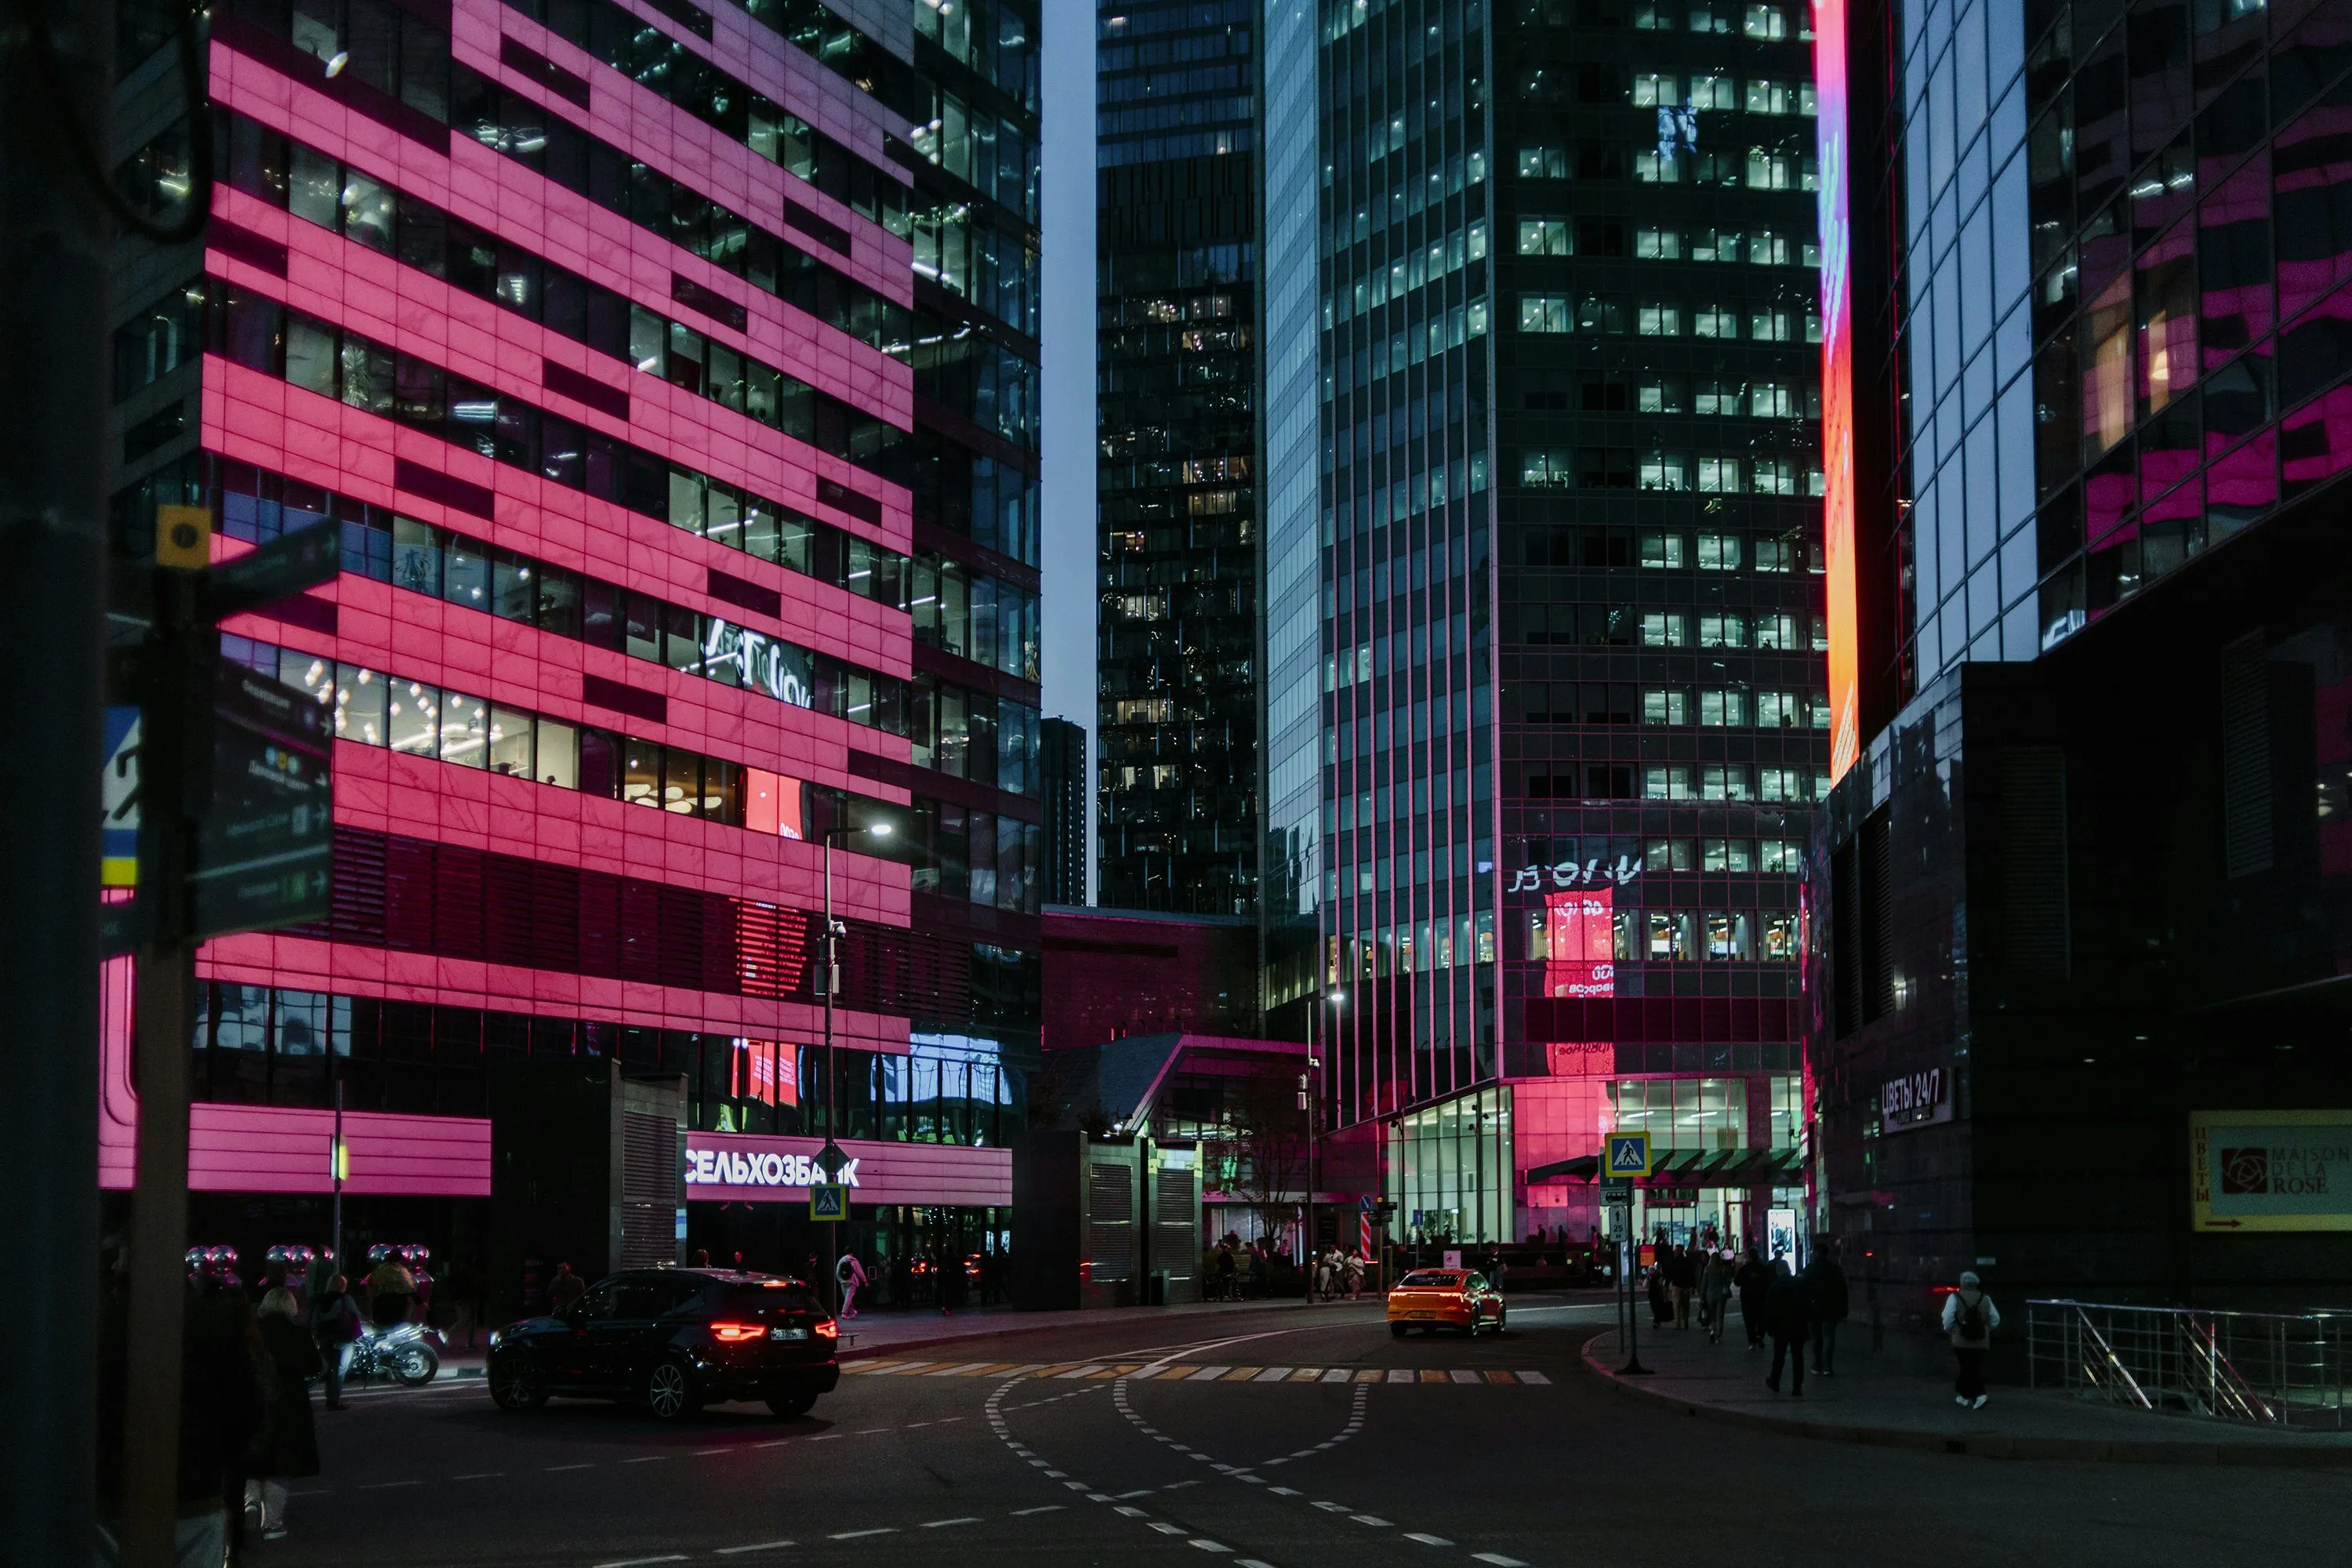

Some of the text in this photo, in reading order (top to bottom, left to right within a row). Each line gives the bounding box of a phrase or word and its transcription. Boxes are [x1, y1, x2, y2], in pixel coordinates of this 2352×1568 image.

[1882, 1067, 1940, 1119] ЦВЕТЫ 24/7
[2272, 1147, 2350, 1162] MAISON
[2272, 1178, 2328, 1195] ROSE
